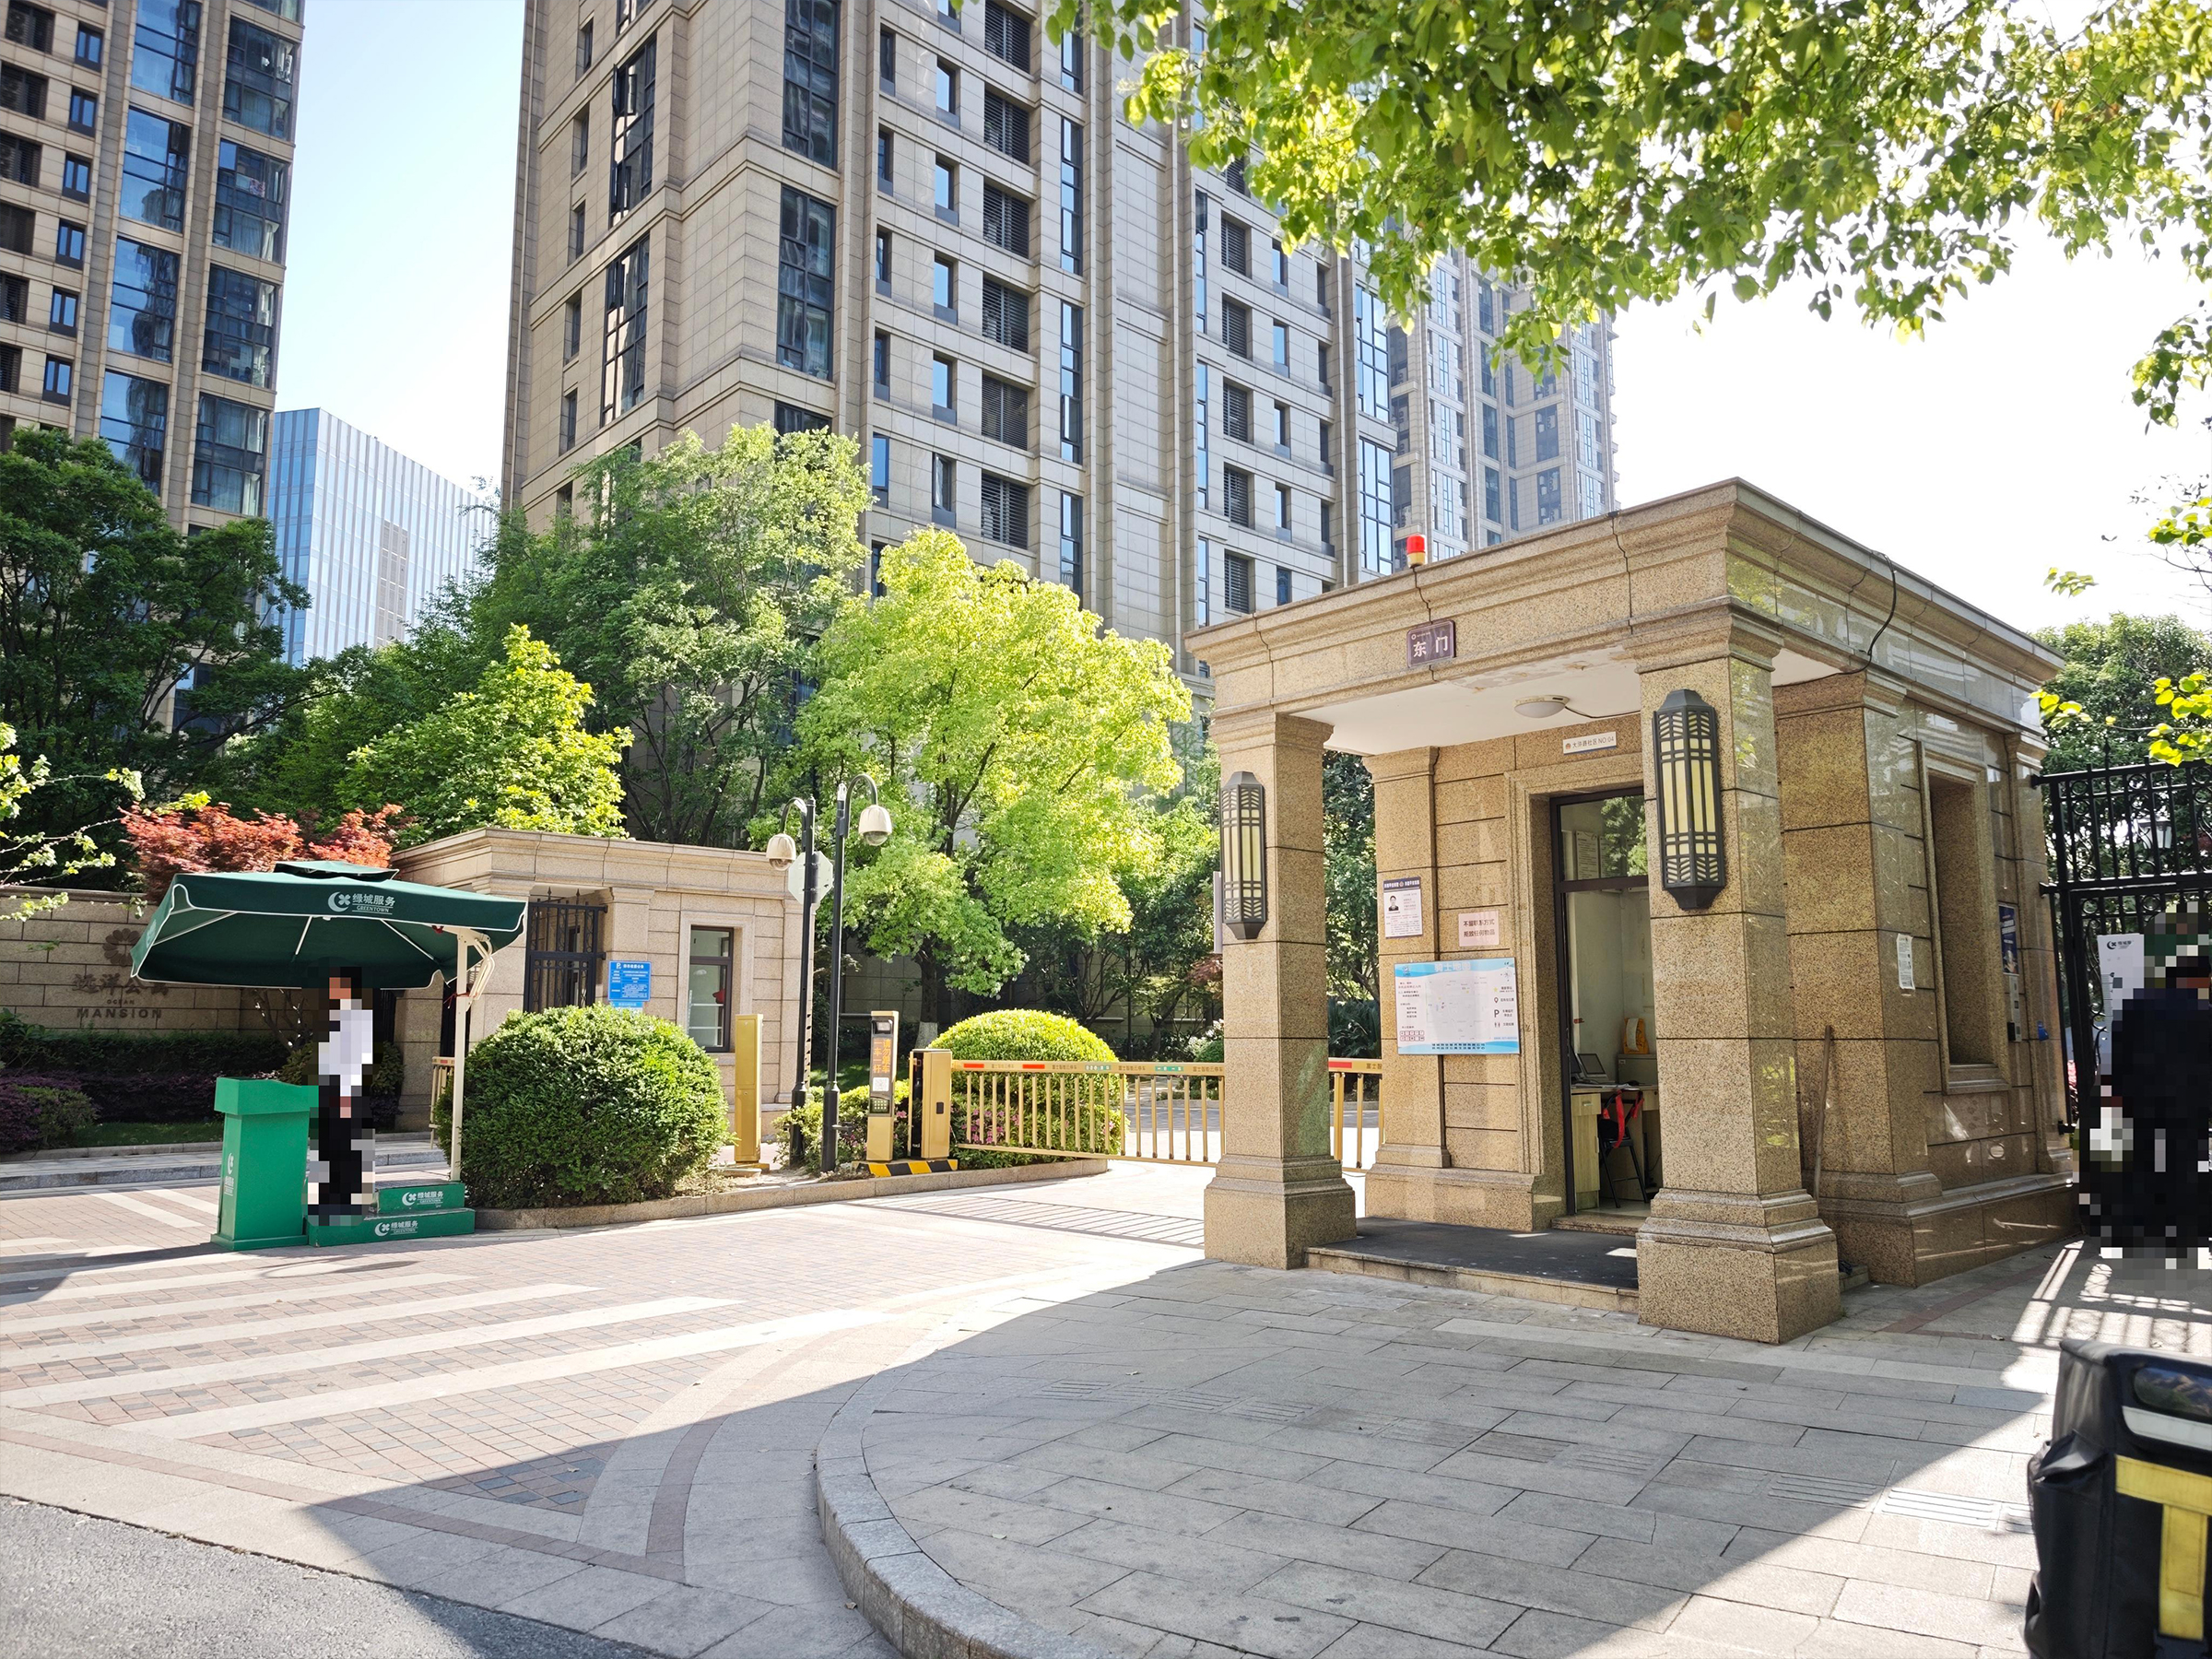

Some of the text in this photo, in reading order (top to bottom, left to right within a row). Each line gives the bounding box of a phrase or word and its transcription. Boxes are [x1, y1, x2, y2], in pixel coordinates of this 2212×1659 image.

[1413, 636, 1448, 657] 东门
[353, 893, 395, 907] 绿城服务
[76, 1007, 162, 1019] MANSION
[873, 1041, 882, 1074] 一车一杆
[391, 1220, 418, 1229] 绿城服务
